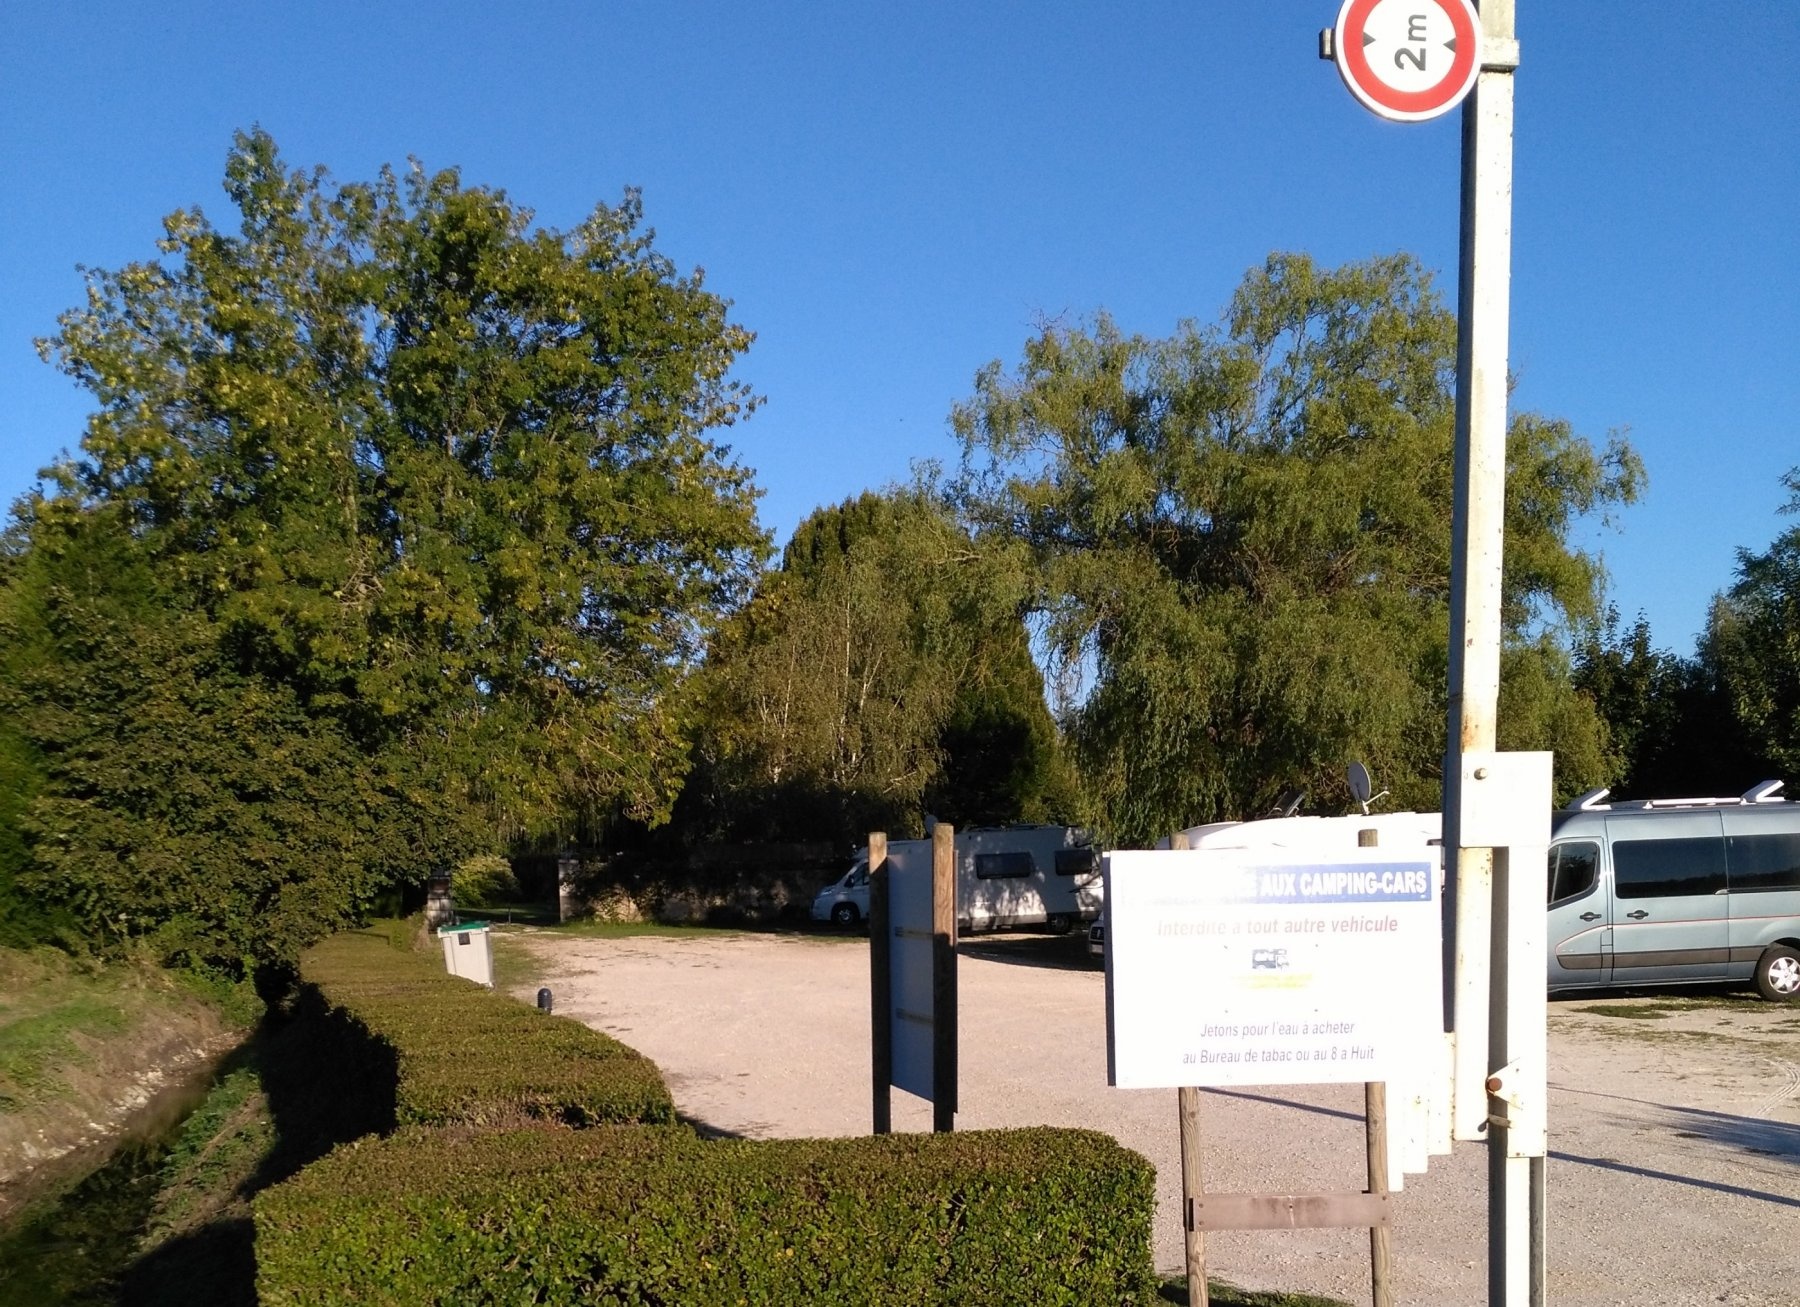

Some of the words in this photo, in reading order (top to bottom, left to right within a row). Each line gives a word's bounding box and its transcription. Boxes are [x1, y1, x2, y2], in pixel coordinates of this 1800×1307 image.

[1261, 873, 1296, 897] AUX
[1299, 870, 1427, 896] CAMPING-CARS
[1247, 918, 1279, 934] tout
[1284, 917, 1326, 934] autre
[1200, 1023, 1239, 1037] Jetons
[1241, 1024, 1269, 1039] pour
[1272, 1021, 1299, 1036] l'eau
[1312, 1021, 1355, 1035] acheter
[1183, 1052, 1196, 1064] au
[1200, 1050, 1241, 1064] Bureau
[1244, 1048, 1258, 1062] de
[1261, 1048, 1292, 1062] tabac
[1296, 1049, 1310, 1061] ou
[1313, 1048, 1327, 1061] au
[1331, 1046, 1338, 1060] 8
[1351, 1045, 1374, 1060] Huit
